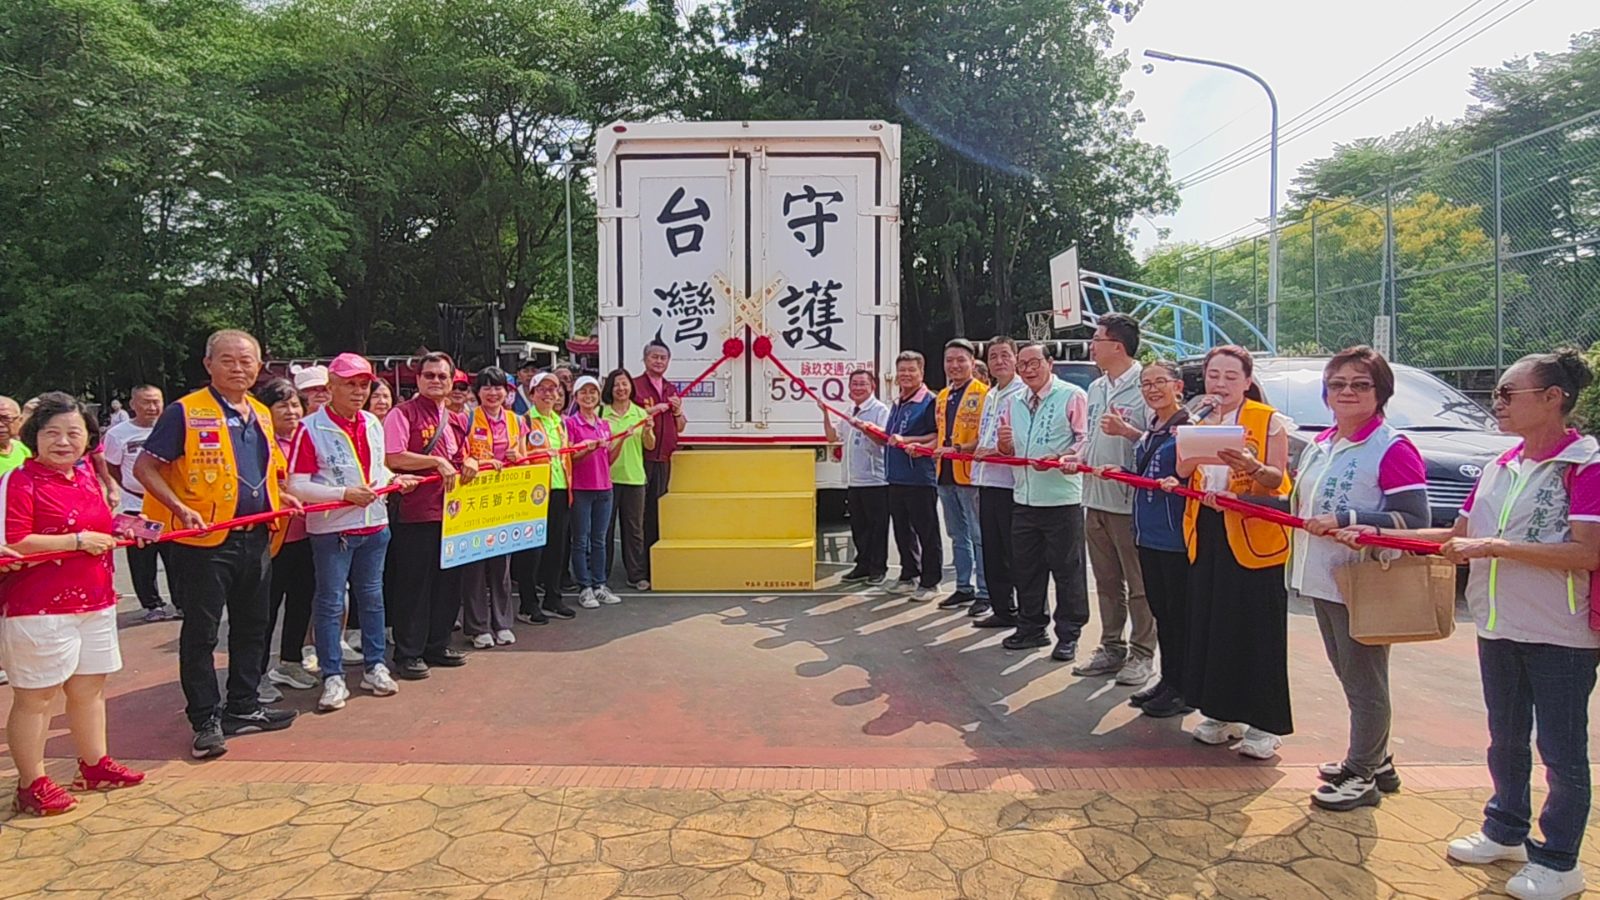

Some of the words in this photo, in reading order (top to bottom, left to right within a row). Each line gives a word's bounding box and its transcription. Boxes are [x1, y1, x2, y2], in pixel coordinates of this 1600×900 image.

[652, 187, 715, 351] 台灣
[779, 185, 847, 352] 守護
[466, 490, 528, 512] 天后獅子會
[1320, 476, 1338, 515] 調解委
